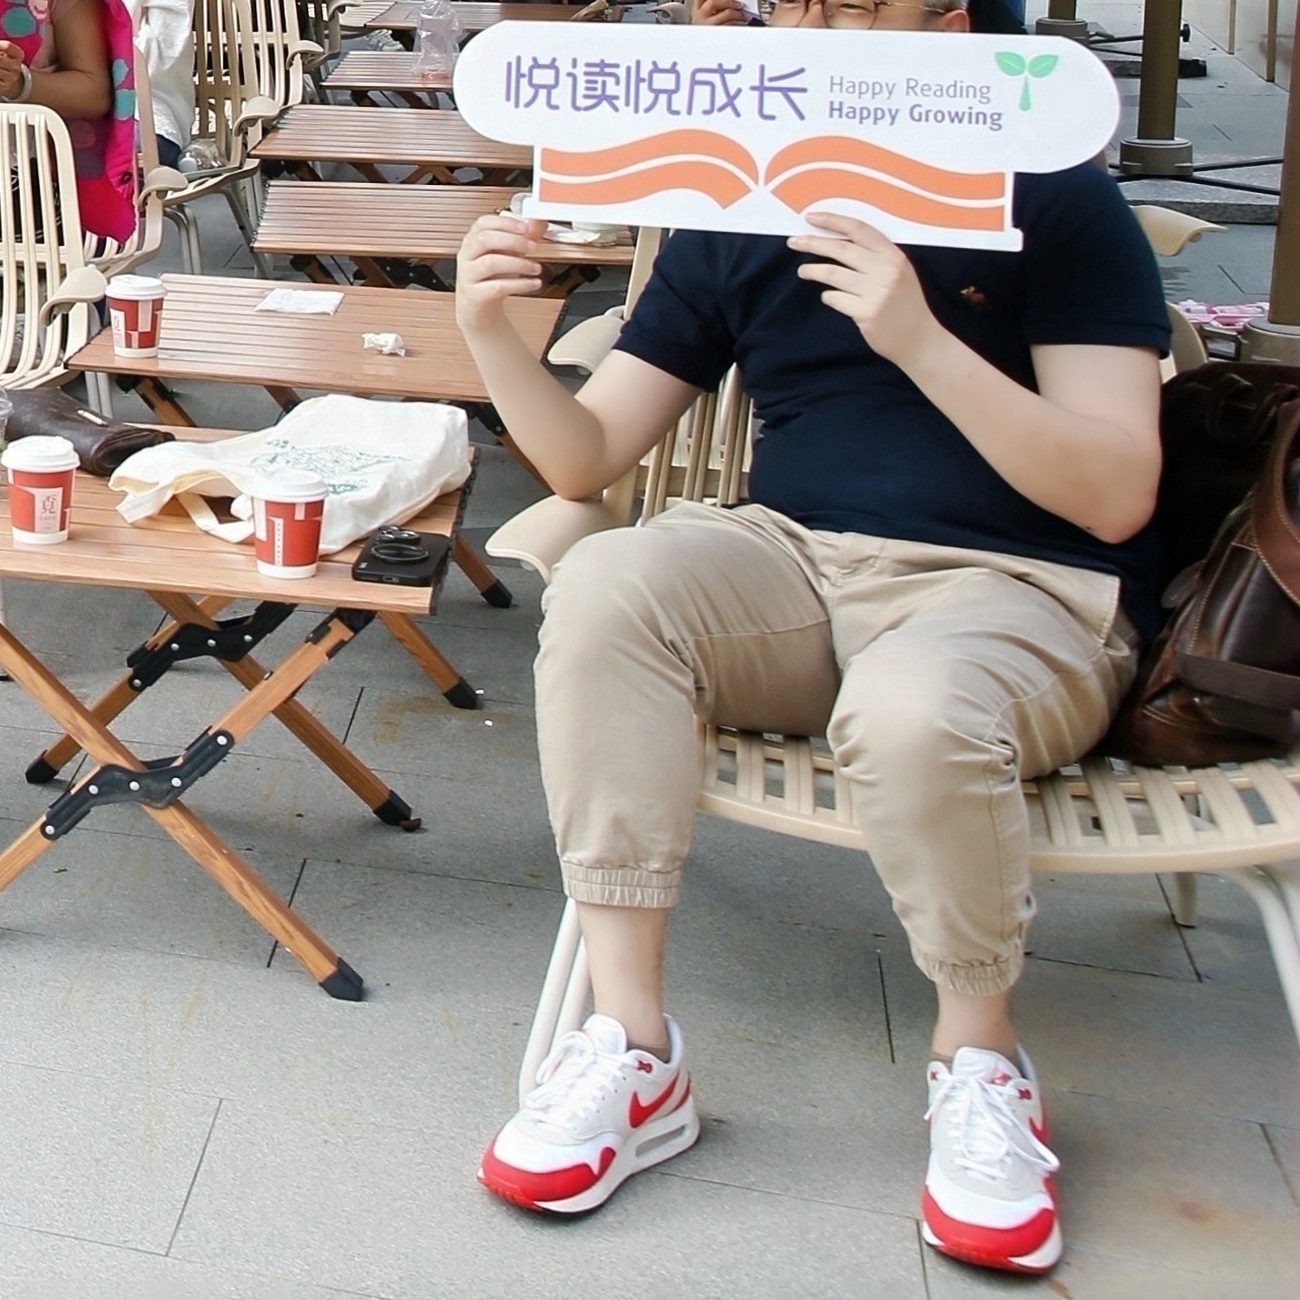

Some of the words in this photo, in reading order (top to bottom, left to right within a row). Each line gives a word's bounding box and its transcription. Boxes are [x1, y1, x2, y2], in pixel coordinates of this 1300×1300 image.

[504, 54, 808, 122] 悦读悦成长
[828, 75, 897, 101] Happy
[905, 77, 992, 104] Reading
[827, 101, 900, 126] Happy
[908, 103, 1004, 131] Growing
